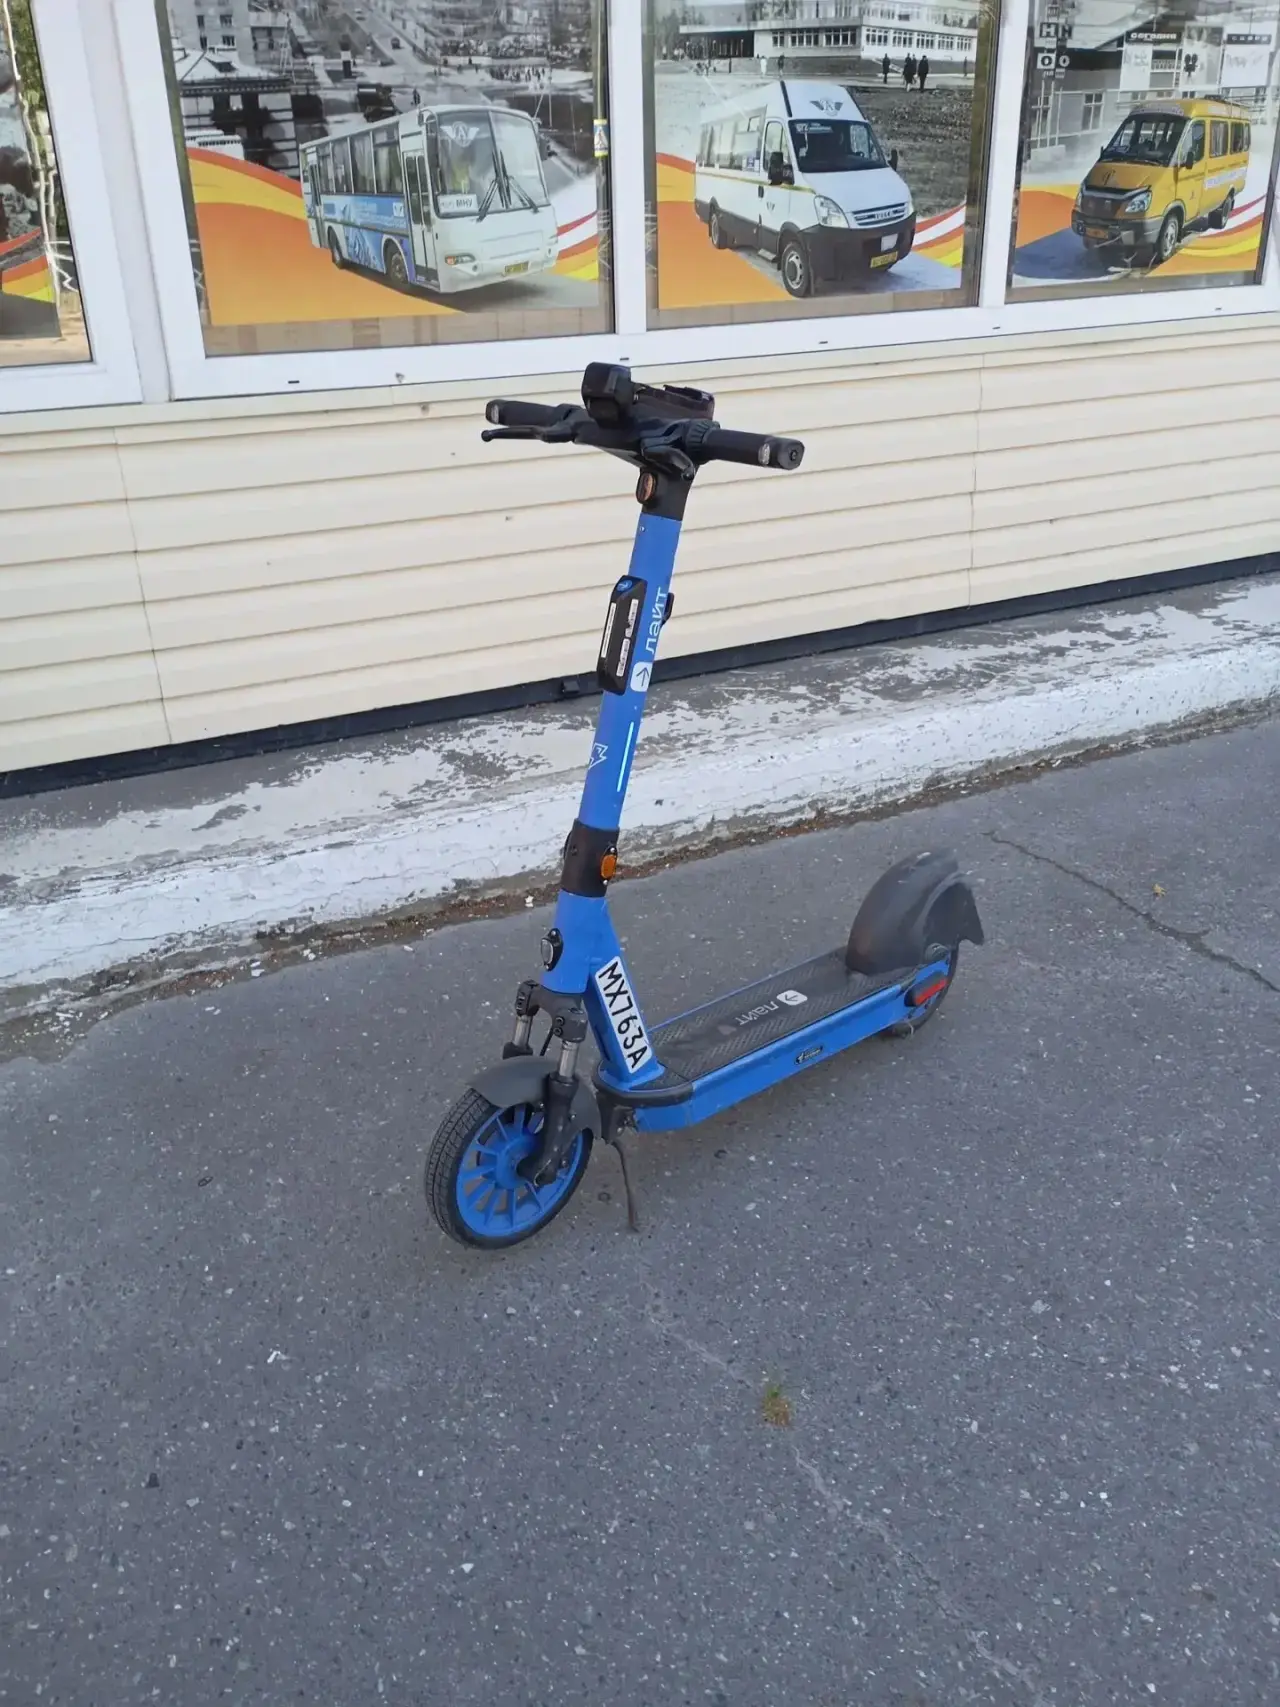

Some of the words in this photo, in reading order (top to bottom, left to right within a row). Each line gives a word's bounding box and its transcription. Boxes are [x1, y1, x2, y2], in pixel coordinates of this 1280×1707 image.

[1130, 32, 1177, 41] сегодня
[645, 586, 667, 655] лайт
[598, 961, 648, 1069] MX763A
[735, 1000, 779, 1026] лайт
